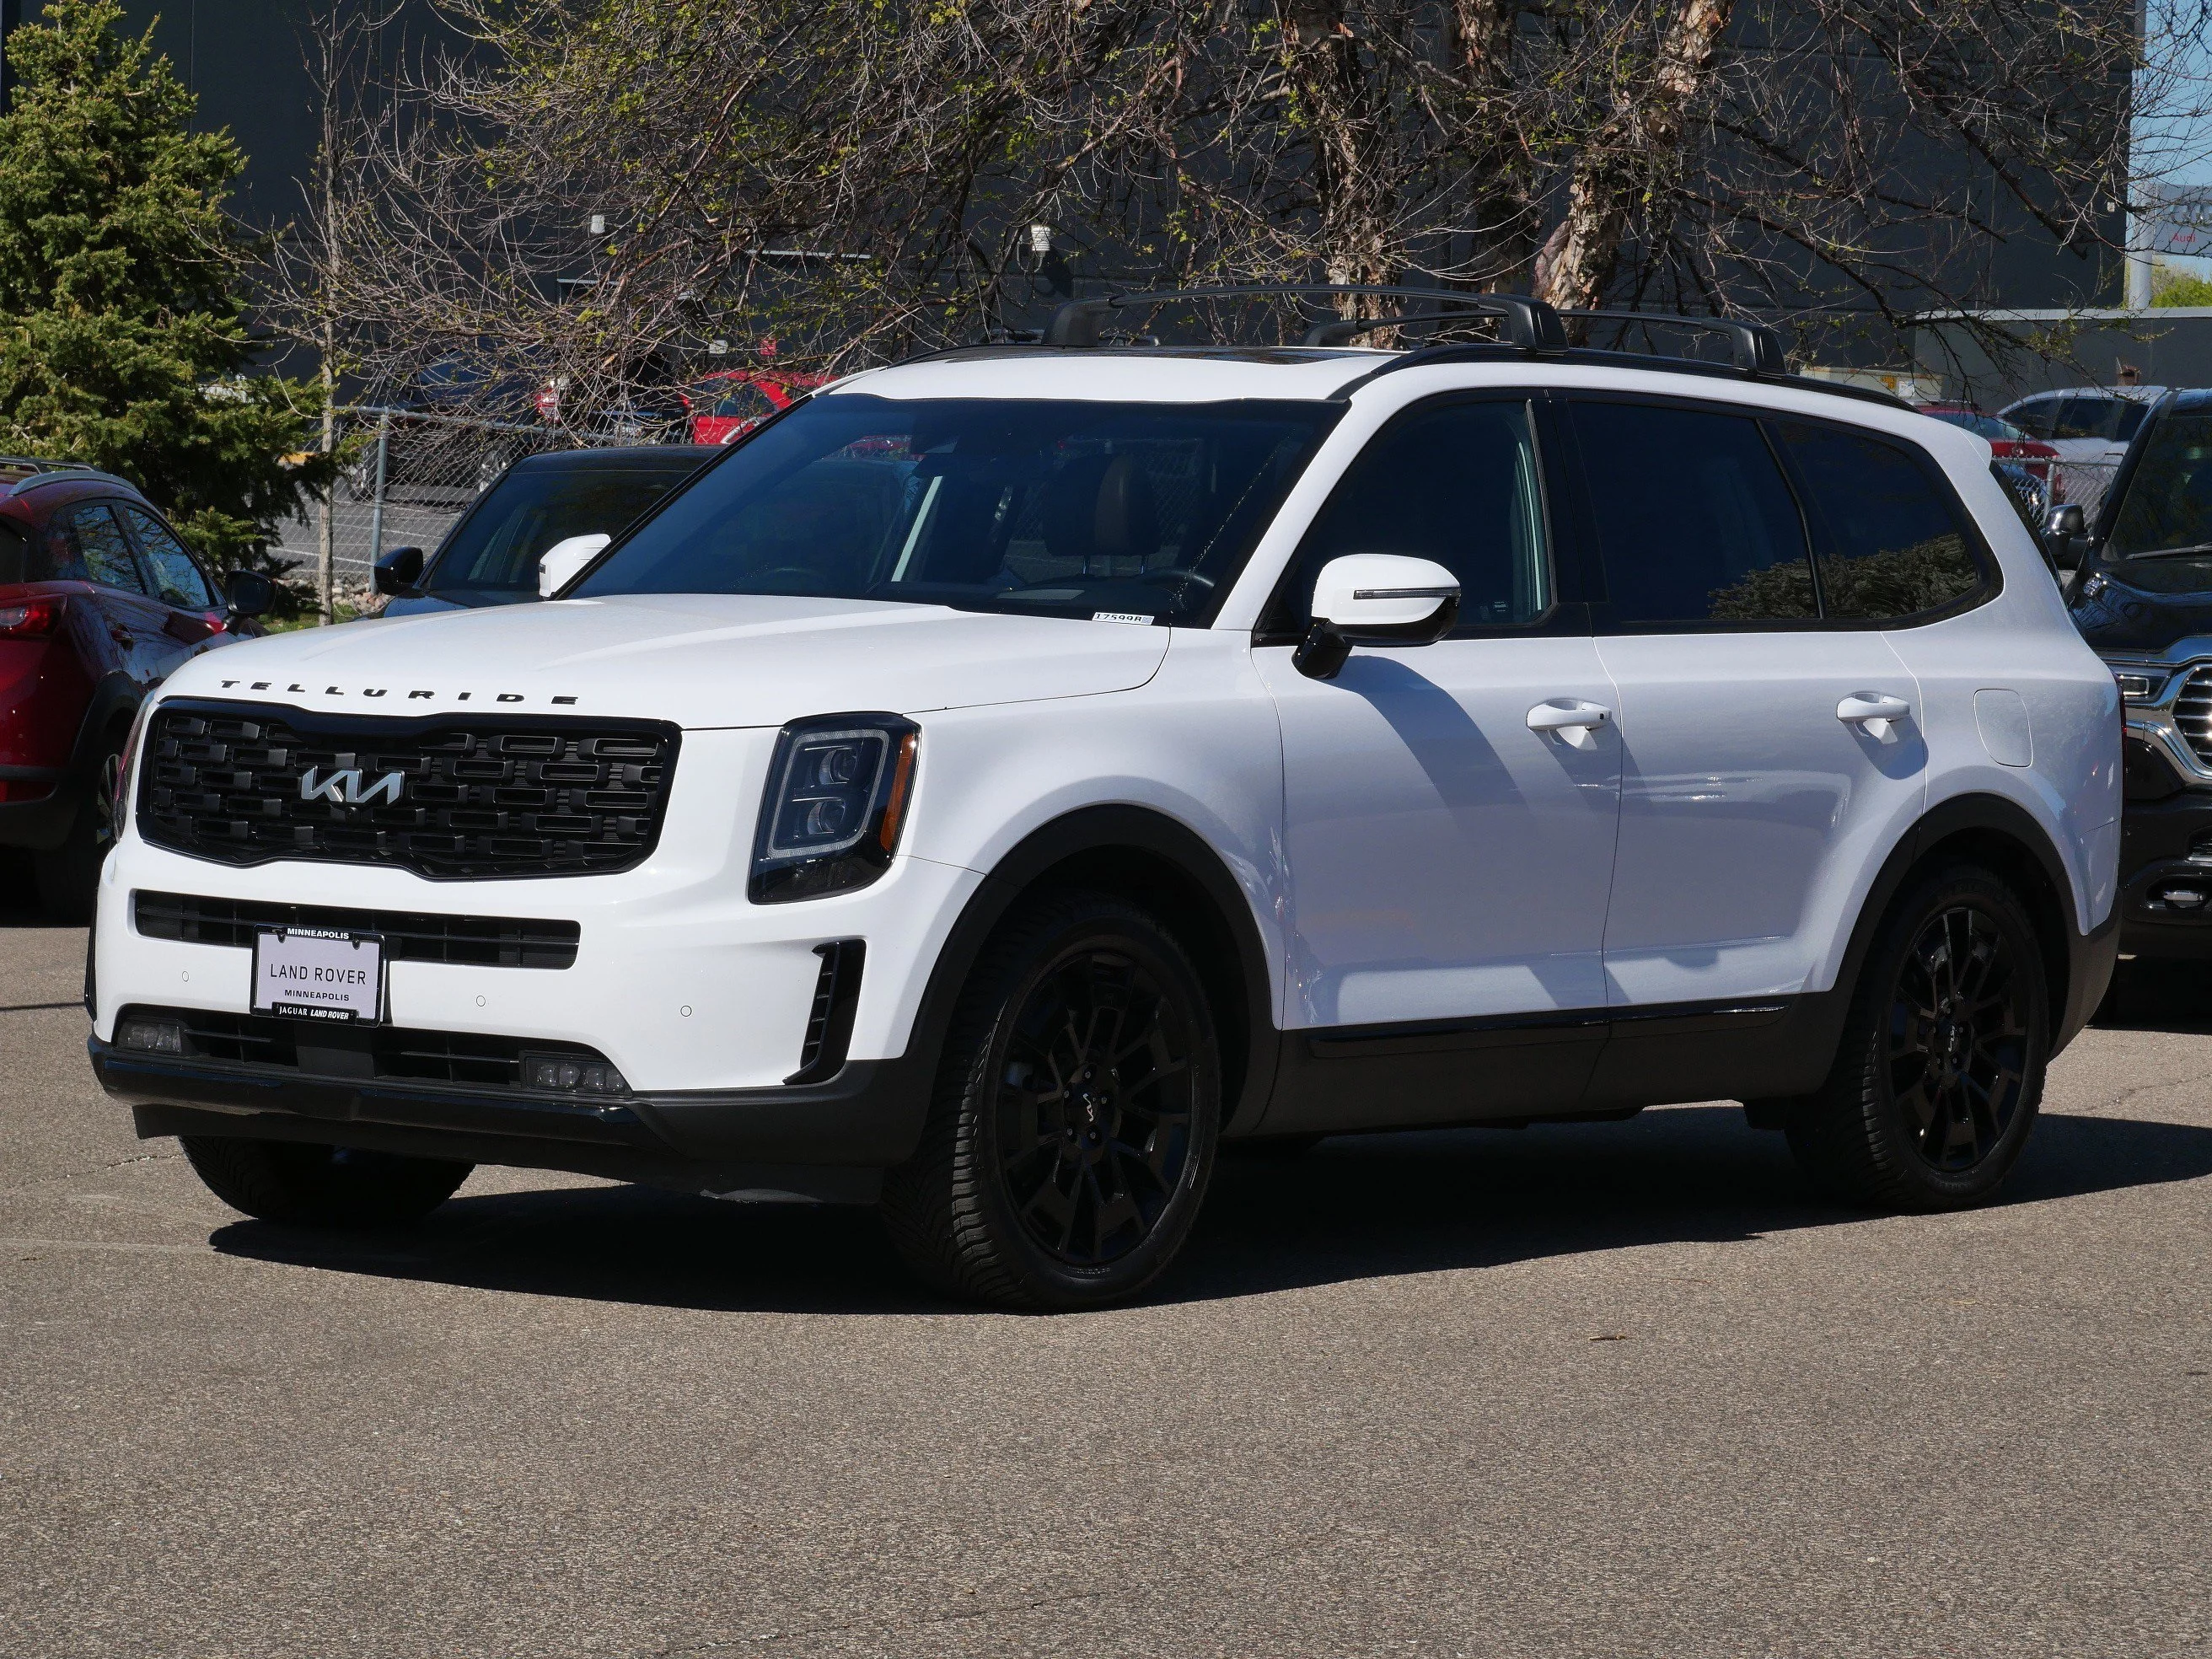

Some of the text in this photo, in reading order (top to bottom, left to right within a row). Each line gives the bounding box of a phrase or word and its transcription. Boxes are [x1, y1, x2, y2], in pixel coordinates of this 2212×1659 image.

[2172, 233, 2196, 242] Audi
[221, 680, 578, 705] TELLURIDE
[301, 768, 405, 806] KIA
[287, 928, 350, 940] MINNEAPOLIS
[271, 964, 366, 985] LAND ROVER
[284, 990, 350, 1001] MINNEAPOLIS
[279, 1007, 308, 1016] JAGUAR
